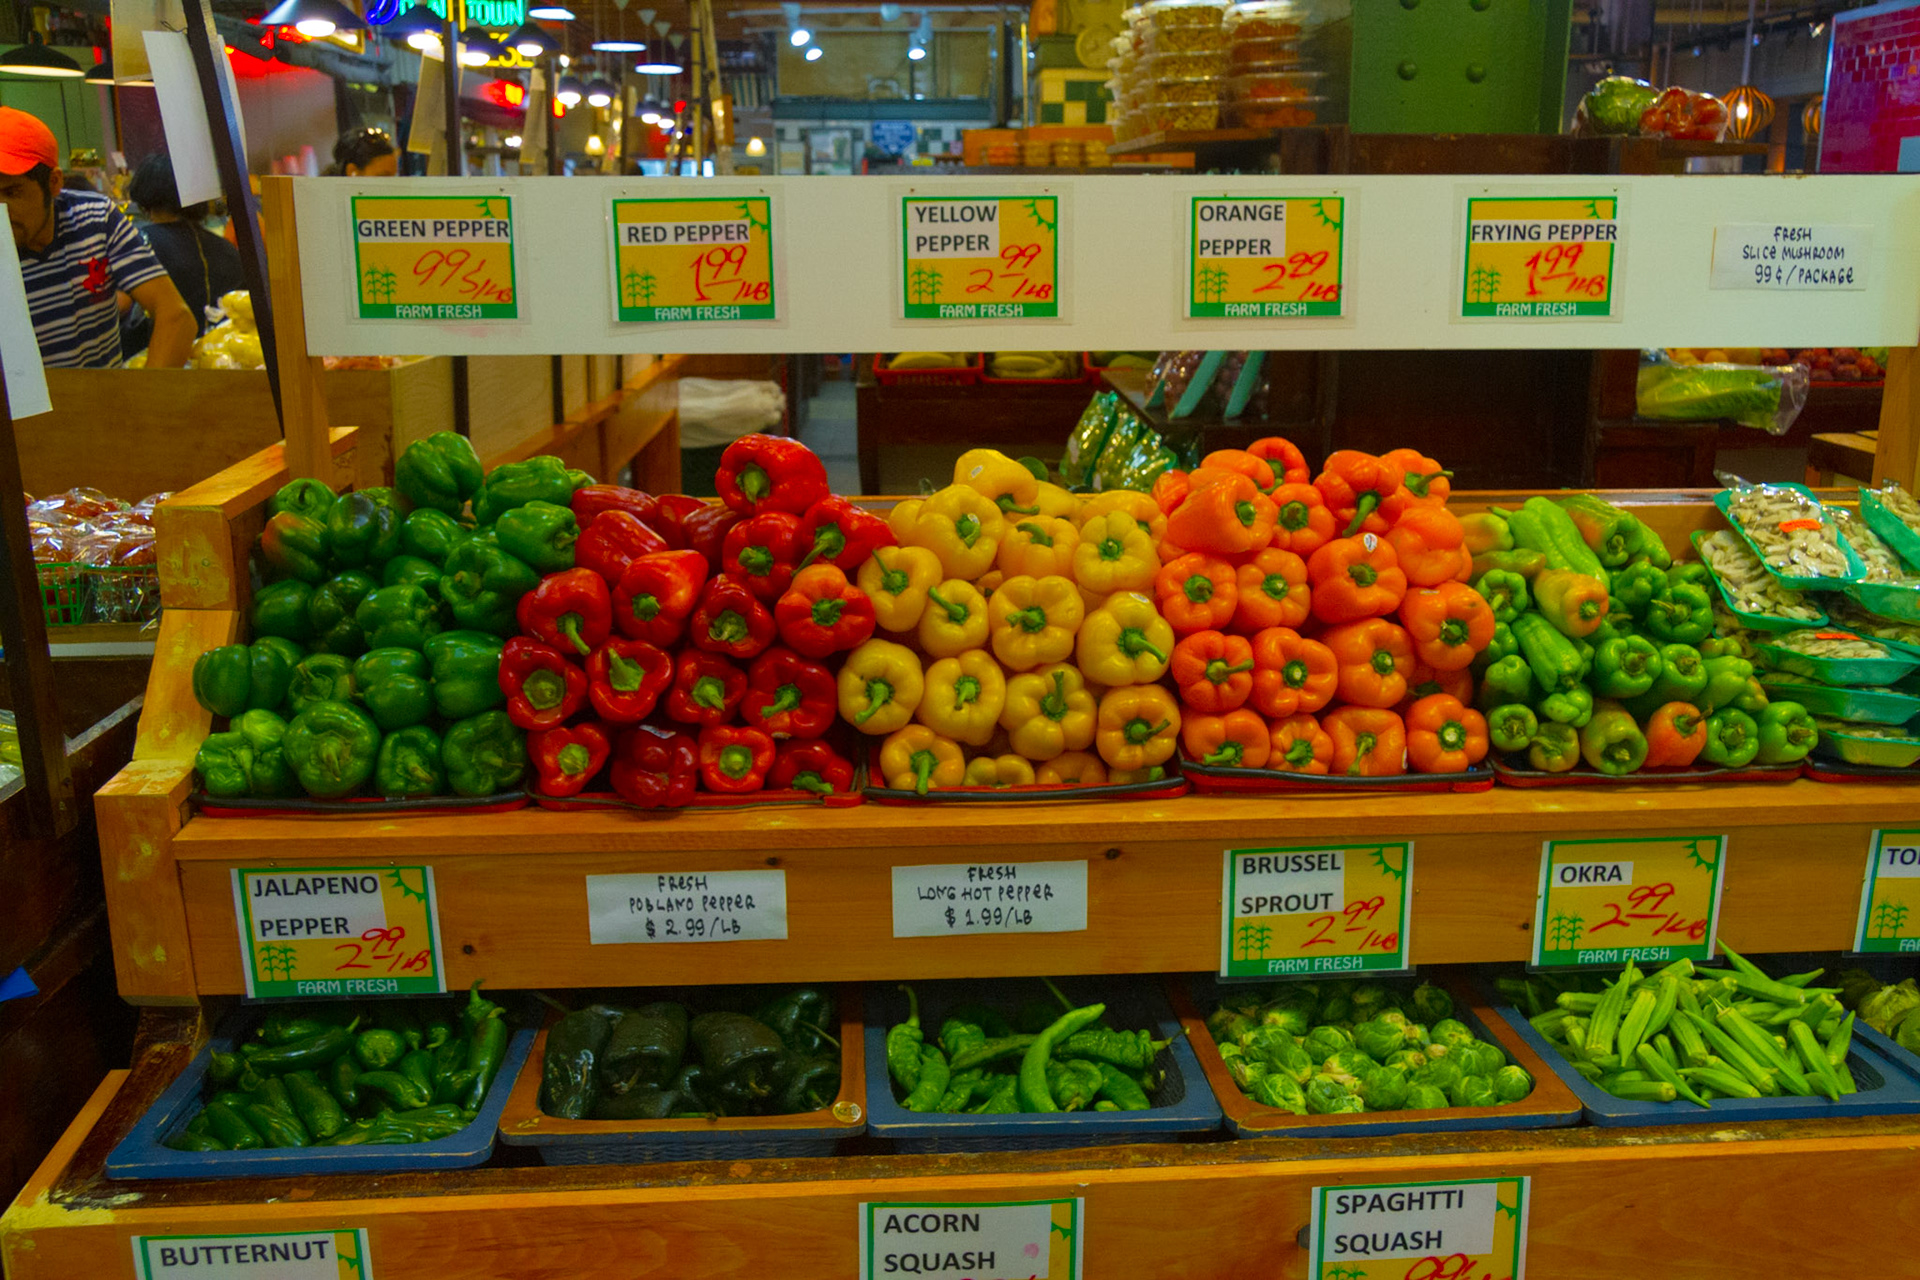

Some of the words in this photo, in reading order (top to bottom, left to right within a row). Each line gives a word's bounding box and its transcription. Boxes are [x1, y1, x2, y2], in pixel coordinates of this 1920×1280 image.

[915, 205, 997, 223] YELLOW
[1199, 204, 1284, 222] ORANGE
[358, 220, 426, 237] GREEN
[433, 220, 509, 237] PEPPER
[627, 226, 667, 243] RED
[674, 223, 749, 242] PEPPER
[1471, 224, 1541, 241] FRYING
[1548, 224, 1617, 241] PEPPER
[916, 234, 990, 252] PEPPER
[1199, 238, 1272, 255] PEPPER
[1782, 246, 1845, 261] MUSHROOM
[396, 305, 433, 318] FARM
[437, 305, 482, 318] FRESH
[654, 307, 692, 320] FARM
[696, 306, 740, 319] FRESH
[939, 304, 976, 317] FARM
[980, 304, 1023, 317] FRESH
[1224, 304, 1261, 316] FARM
[1264, 303, 1307, 316] FRESH
[1496, 303, 1531, 316] FARM
[1535, 303, 1577, 316] FRESH
[1243, 853, 1341, 875] BRUSSEL
[1560, 864, 1623, 884] OKRA
[254, 876, 378, 897] JALAPENO
[917, 885, 956, 901] LONG
[961, 887, 992, 901] HOT
[629, 897, 694, 914] POBLANO
[1241, 893, 1334, 915] SPROUT
[260, 916, 350, 937] PEPPER
[1578, 949, 1618, 964] FARM
[1622, 947, 1670, 962] FRESH
[1268, 959, 1309, 973] FARM
[1314, 956, 1363, 971] FRESH
[297, 980, 341, 994] FARM
[346, 979, 399, 993] FRESH
[1335, 1189, 1464, 1215] SPAGHTTI
[883, 1213, 980, 1234] ACORN
[1334, 1229, 1443, 1256] SQUASH
[160, 1240, 330, 1267] BUTTERNUT
[884, 1251, 995, 1275] SQUASH
